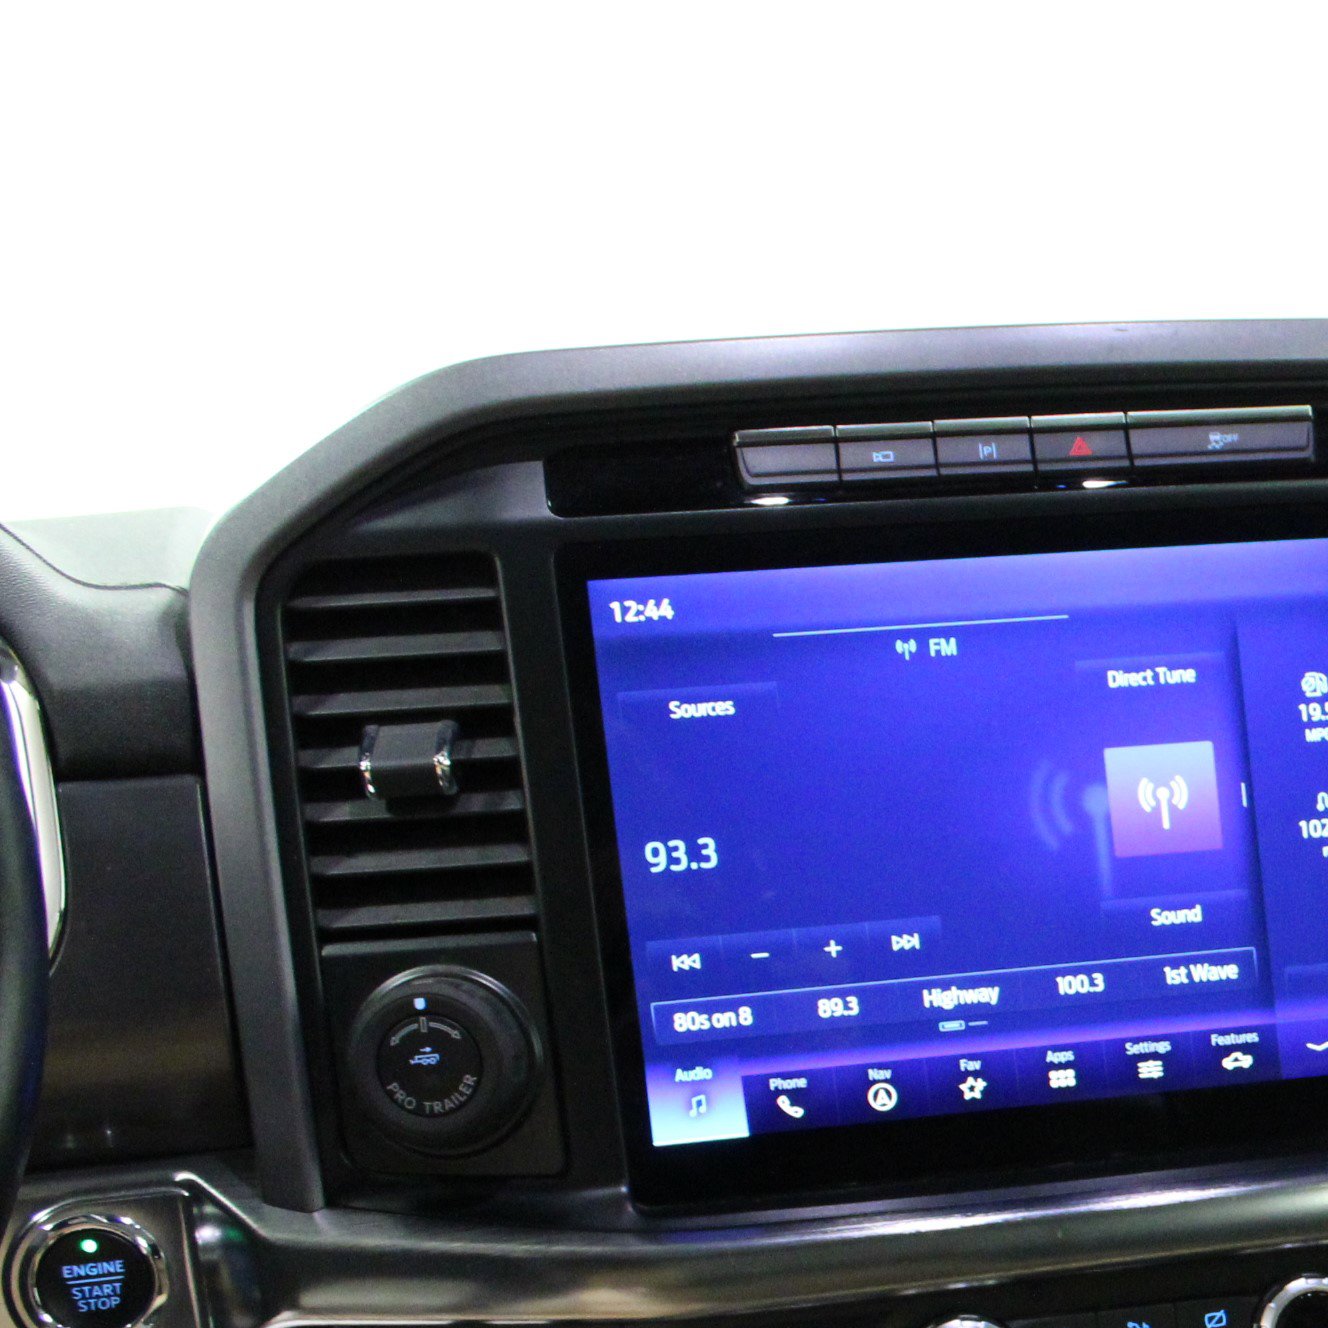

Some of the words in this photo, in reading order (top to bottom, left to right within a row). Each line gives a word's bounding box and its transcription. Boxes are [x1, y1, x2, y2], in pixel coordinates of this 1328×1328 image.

[609, 598, 674, 624] 12:44
[929, 638, 957, 657] FM
[1107, 668, 1153, 688] Direct
[1155, 666, 1196, 686] Tune
[669, 699, 735, 720] Sources
[644, 837, 718, 873] 93.3
[1151, 905, 1202, 927] Sound
[1055, 973, 1105, 996] 100.3
[1163, 965, 1188, 986] 1st
[1190, 963, 1239, 984] Wave
[817, 996, 860, 1019] 89.3
[923, 984, 1000, 1011] Highway
[673, 1010, 710, 1033] 80s
[711, 1013, 737, 1029] on
[738, 1006, 753, 1026] 8
[1125, 1039, 1172, 1057] Settings
[1210, 1029, 1259, 1047] Features
[959, 1058, 982, 1073] Fav
[1046, 1049, 1075, 1066] Apps
[675, 1066, 713, 1082] Audio
[769, 1074, 808, 1091] Phone
[868, 1068, 892, 1082] Nav
[386, 1081, 417, 1110] PRO
[423, 1073, 478, 1116] TRAILER
[62, 1259, 126, 1279] ENGINE
[71, 1282, 123, 1301] START
[77, 1296, 121, 1313] STOP
